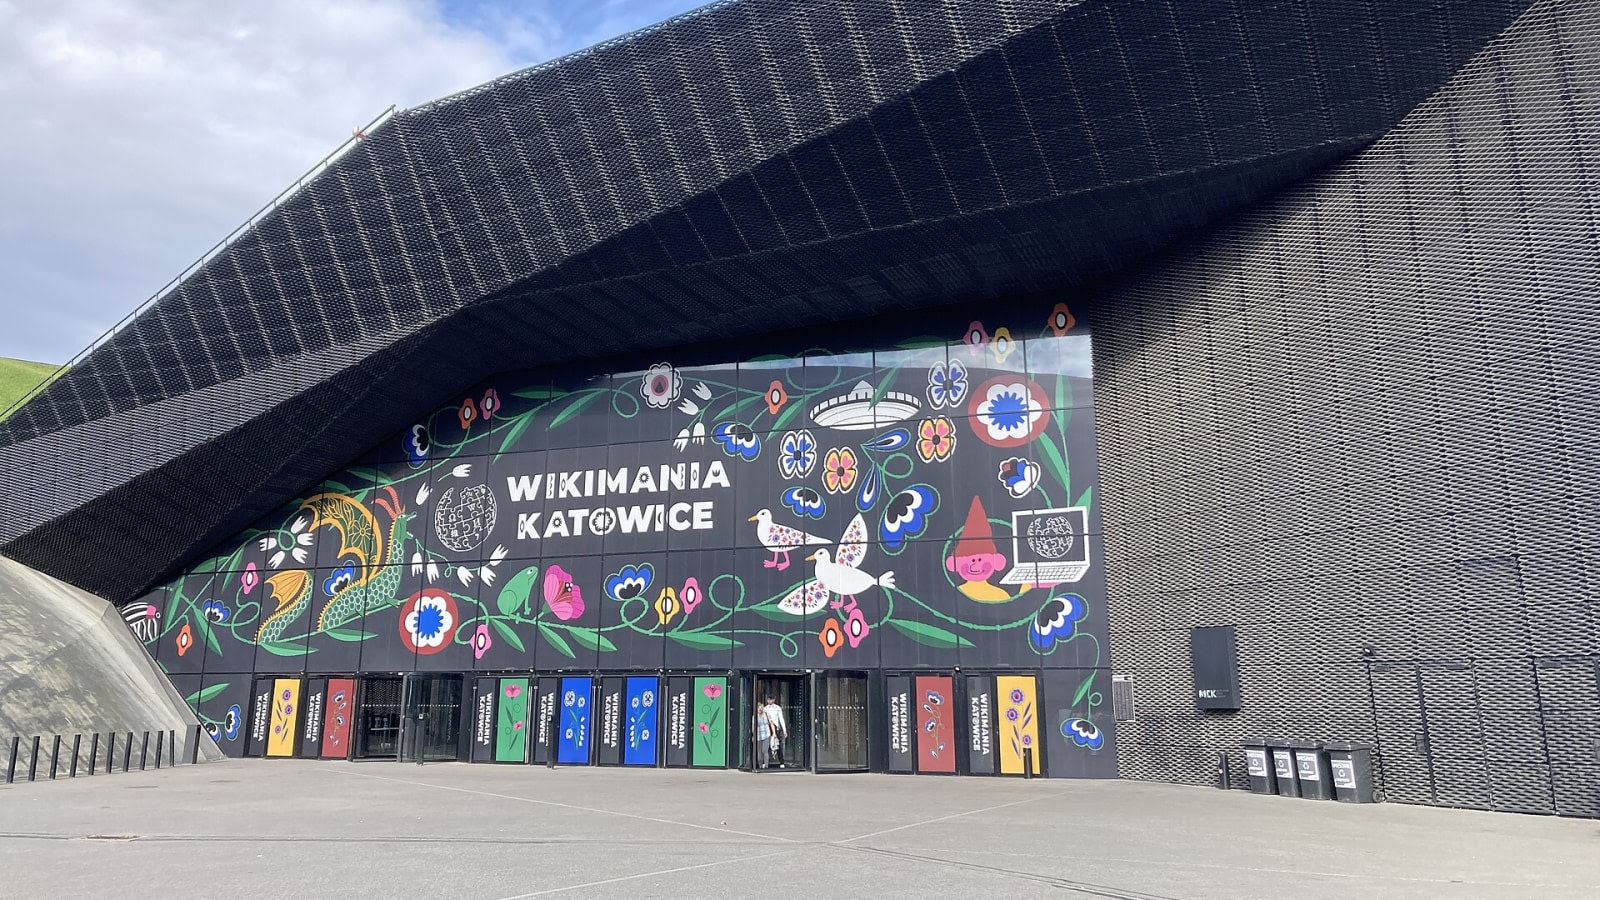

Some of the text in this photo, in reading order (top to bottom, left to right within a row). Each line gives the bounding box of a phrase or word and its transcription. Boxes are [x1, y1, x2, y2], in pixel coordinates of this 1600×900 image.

[507, 460, 731, 502] WIKIMANIA
[517, 501, 714, 540] KATOWICE
[253, 695, 263, 738] KATOWICE
[258, 692, 269, 741] WIKIMANIA
[306, 695, 316, 739] KATOWICE
[311, 692, 322, 742] WIKIMANIA
[477, 695, 486, 742] KATOWICE
[483, 692, 493, 746] WIKIMANIA
[539, 695, 548, 743] KATOWICE
[604, 695, 612, 744] KATOWICE
[610, 692, 619, 748] WIKIMANIA
[671, 695, 680, 746] KATOWICE
[678, 692, 687, 749] WIKIMANIA
[891, 696, 901, 750] KATOWICE
[899, 692, 909, 754] WIKIMANIA
[971, 697, 981, 751] KATOWICE
[979, 692, 990, 755] WIKIMANIA
